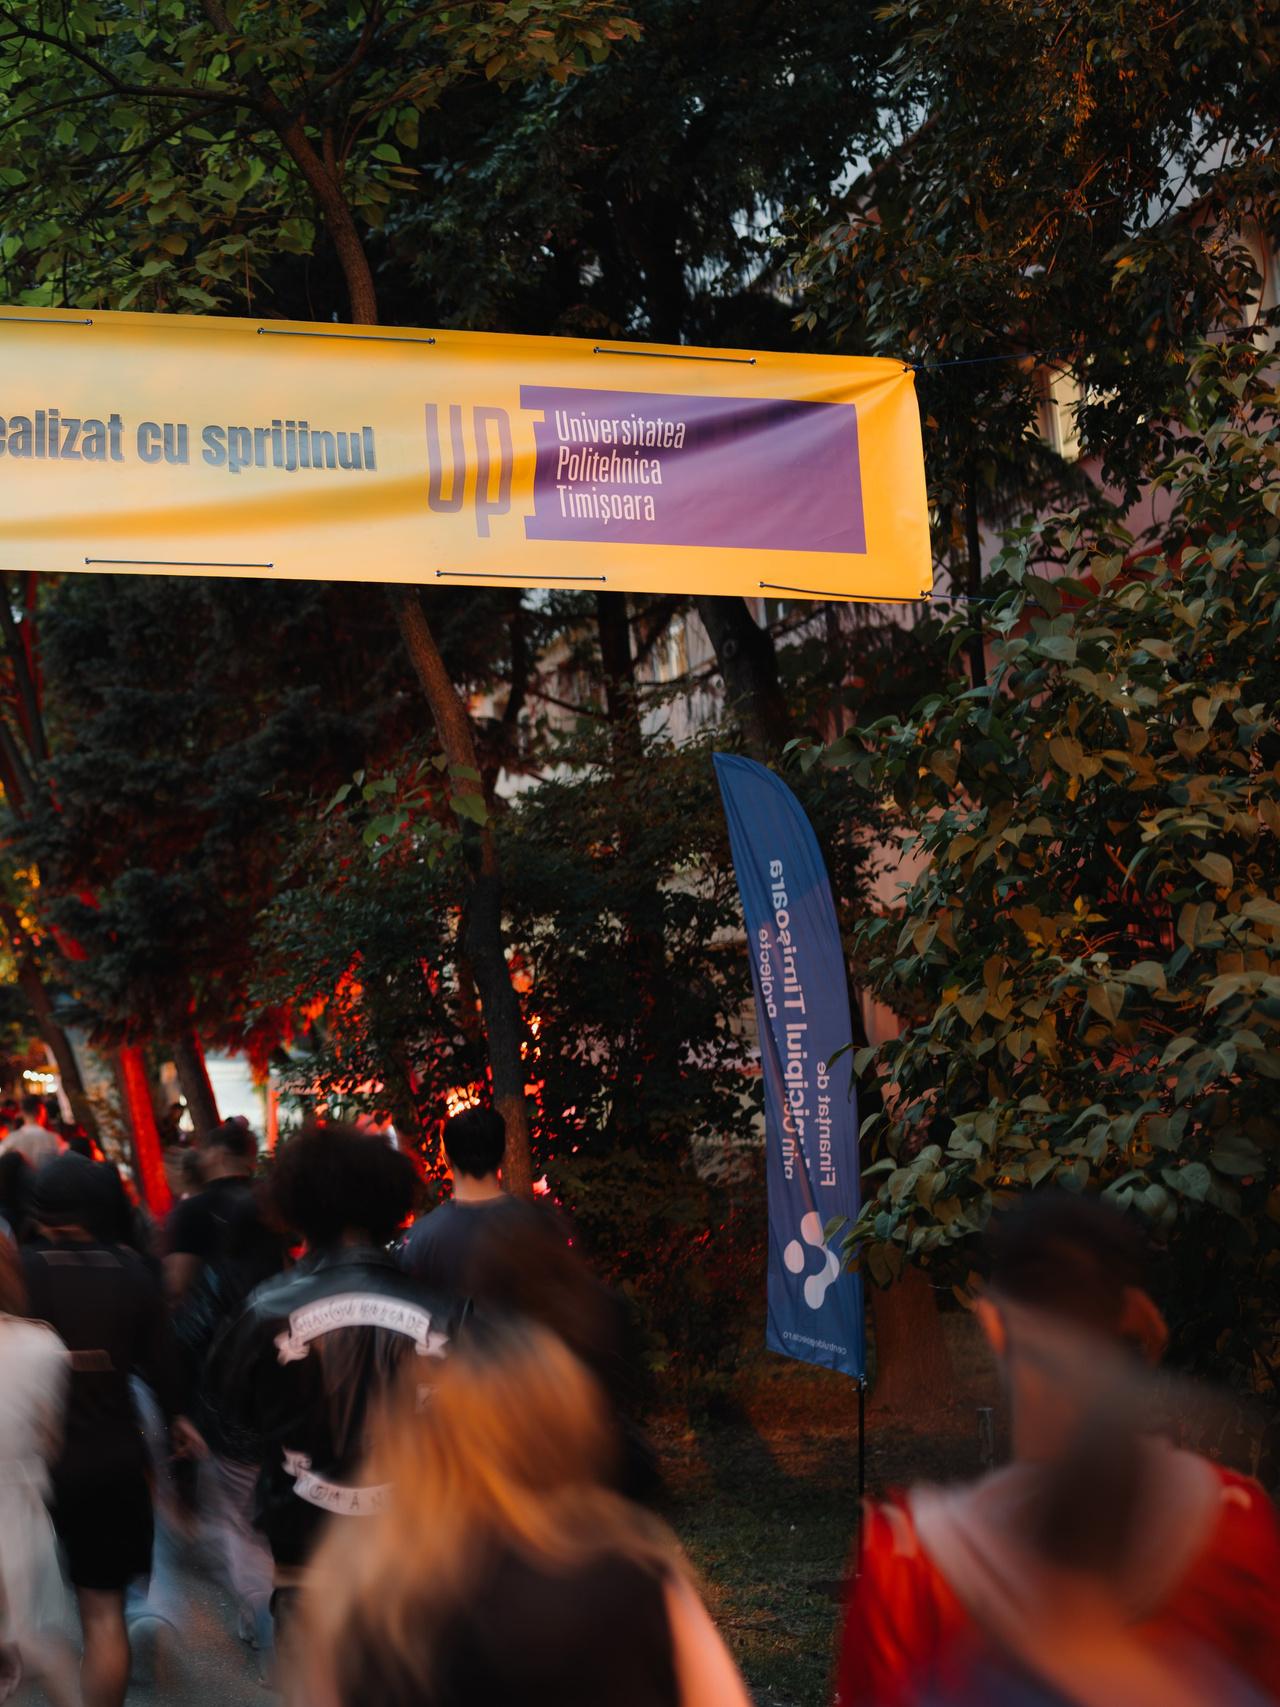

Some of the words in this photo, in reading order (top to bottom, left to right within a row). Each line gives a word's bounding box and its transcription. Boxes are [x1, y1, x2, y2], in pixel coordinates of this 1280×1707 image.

[136, 420, 189, 465] cu
[201, 418, 377, 474] sprijinul
[555, 410, 686, 449] Universitatea
[556, 445, 663, 485] Politehnica
[556, 485, 656, 525] Timișoara
